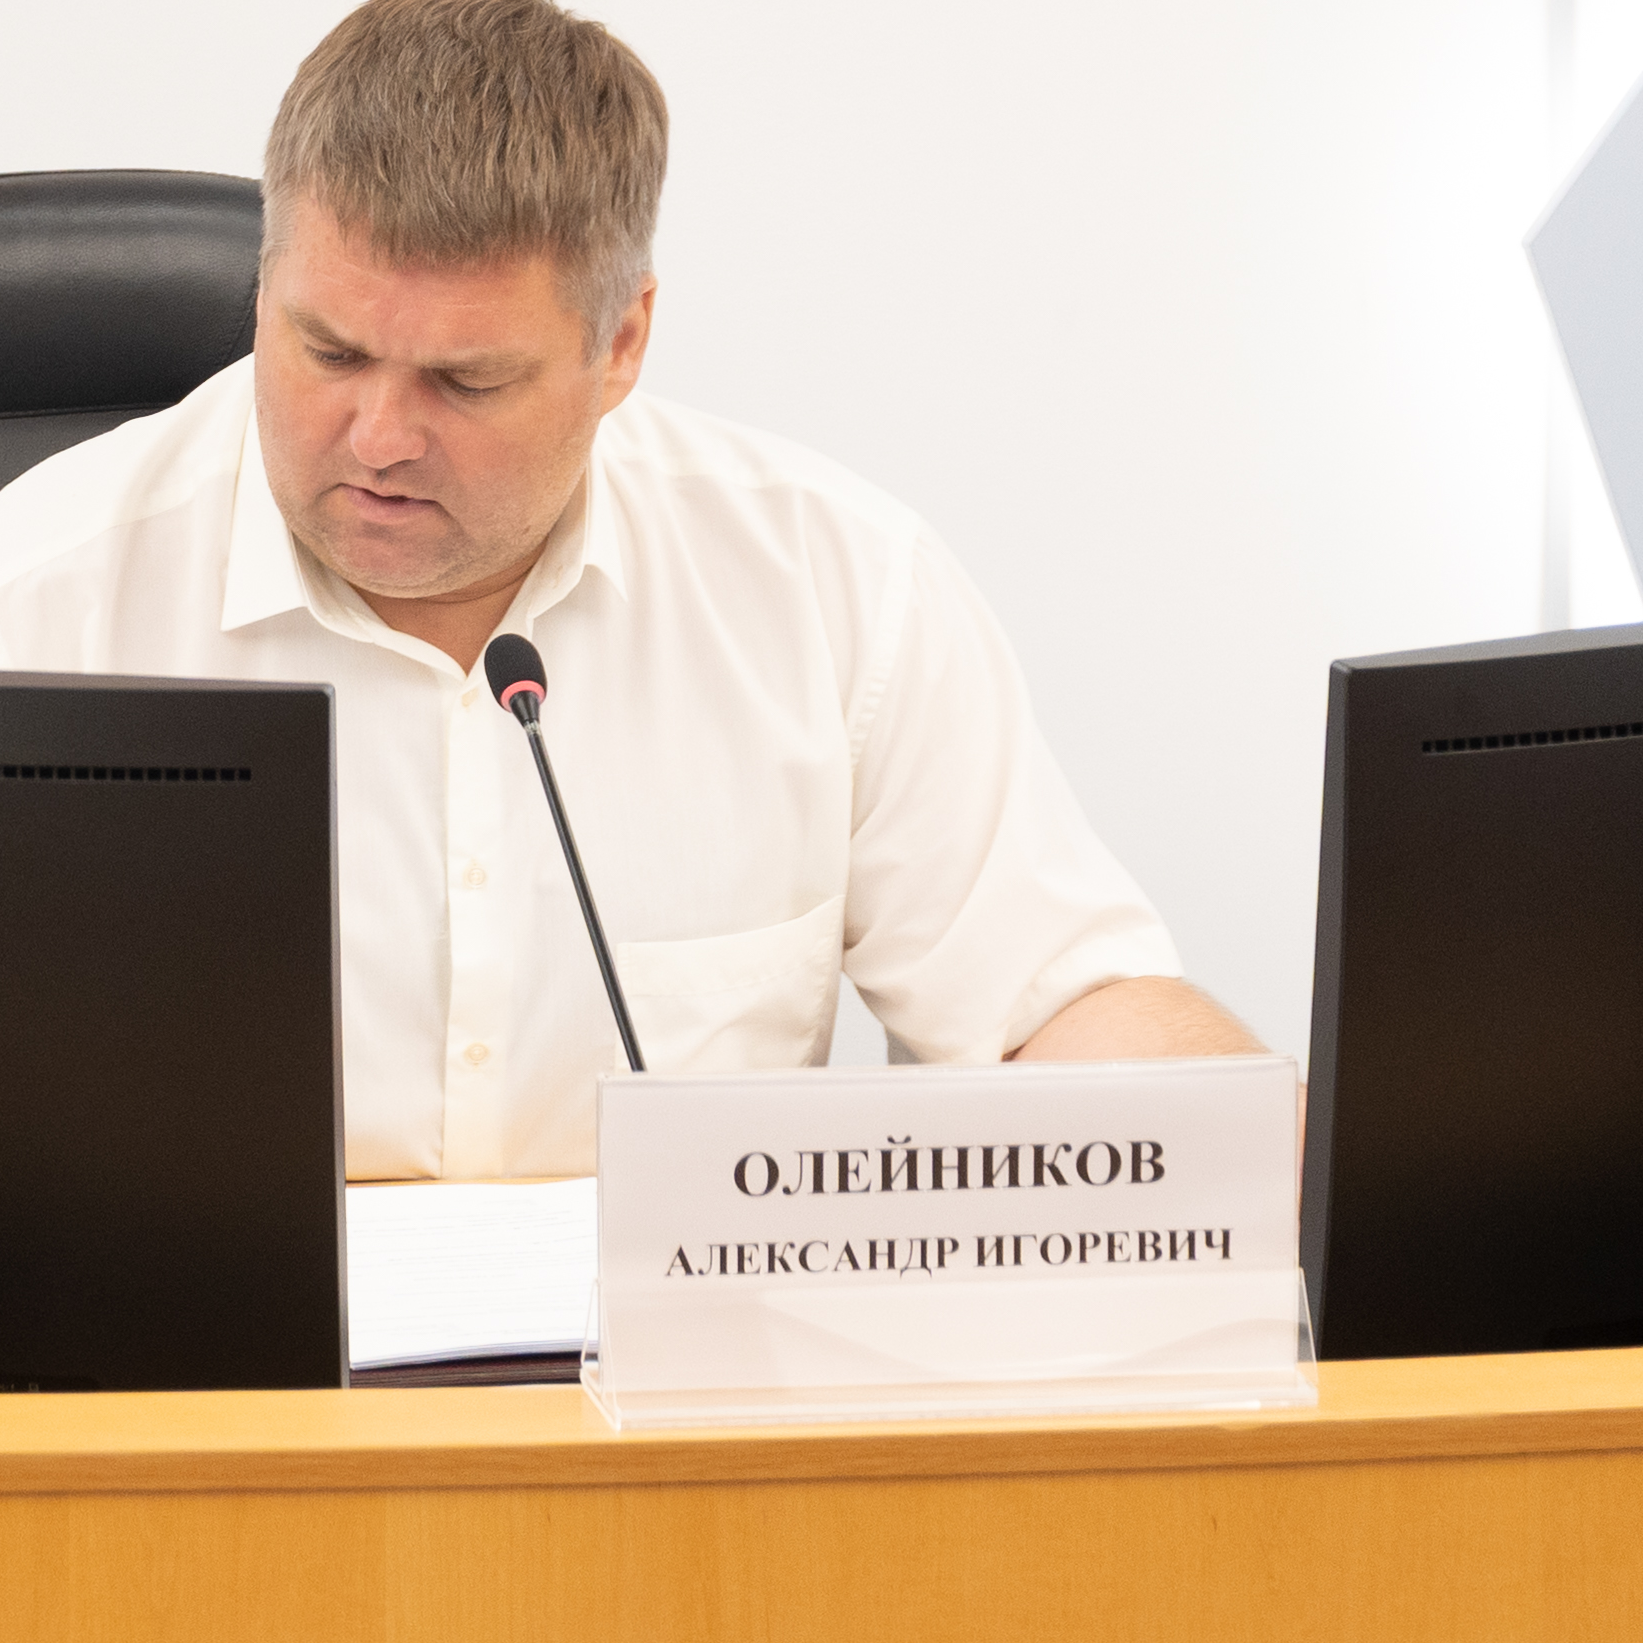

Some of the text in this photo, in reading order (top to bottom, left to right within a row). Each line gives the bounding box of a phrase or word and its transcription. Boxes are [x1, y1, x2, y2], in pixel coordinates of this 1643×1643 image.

[732, 1135, 1167, 1197] ОЛЕЙНИКОВ
[665, 1227, 1235, 1279] АЛЕКСАНДР ИГОРЕВИЧ
